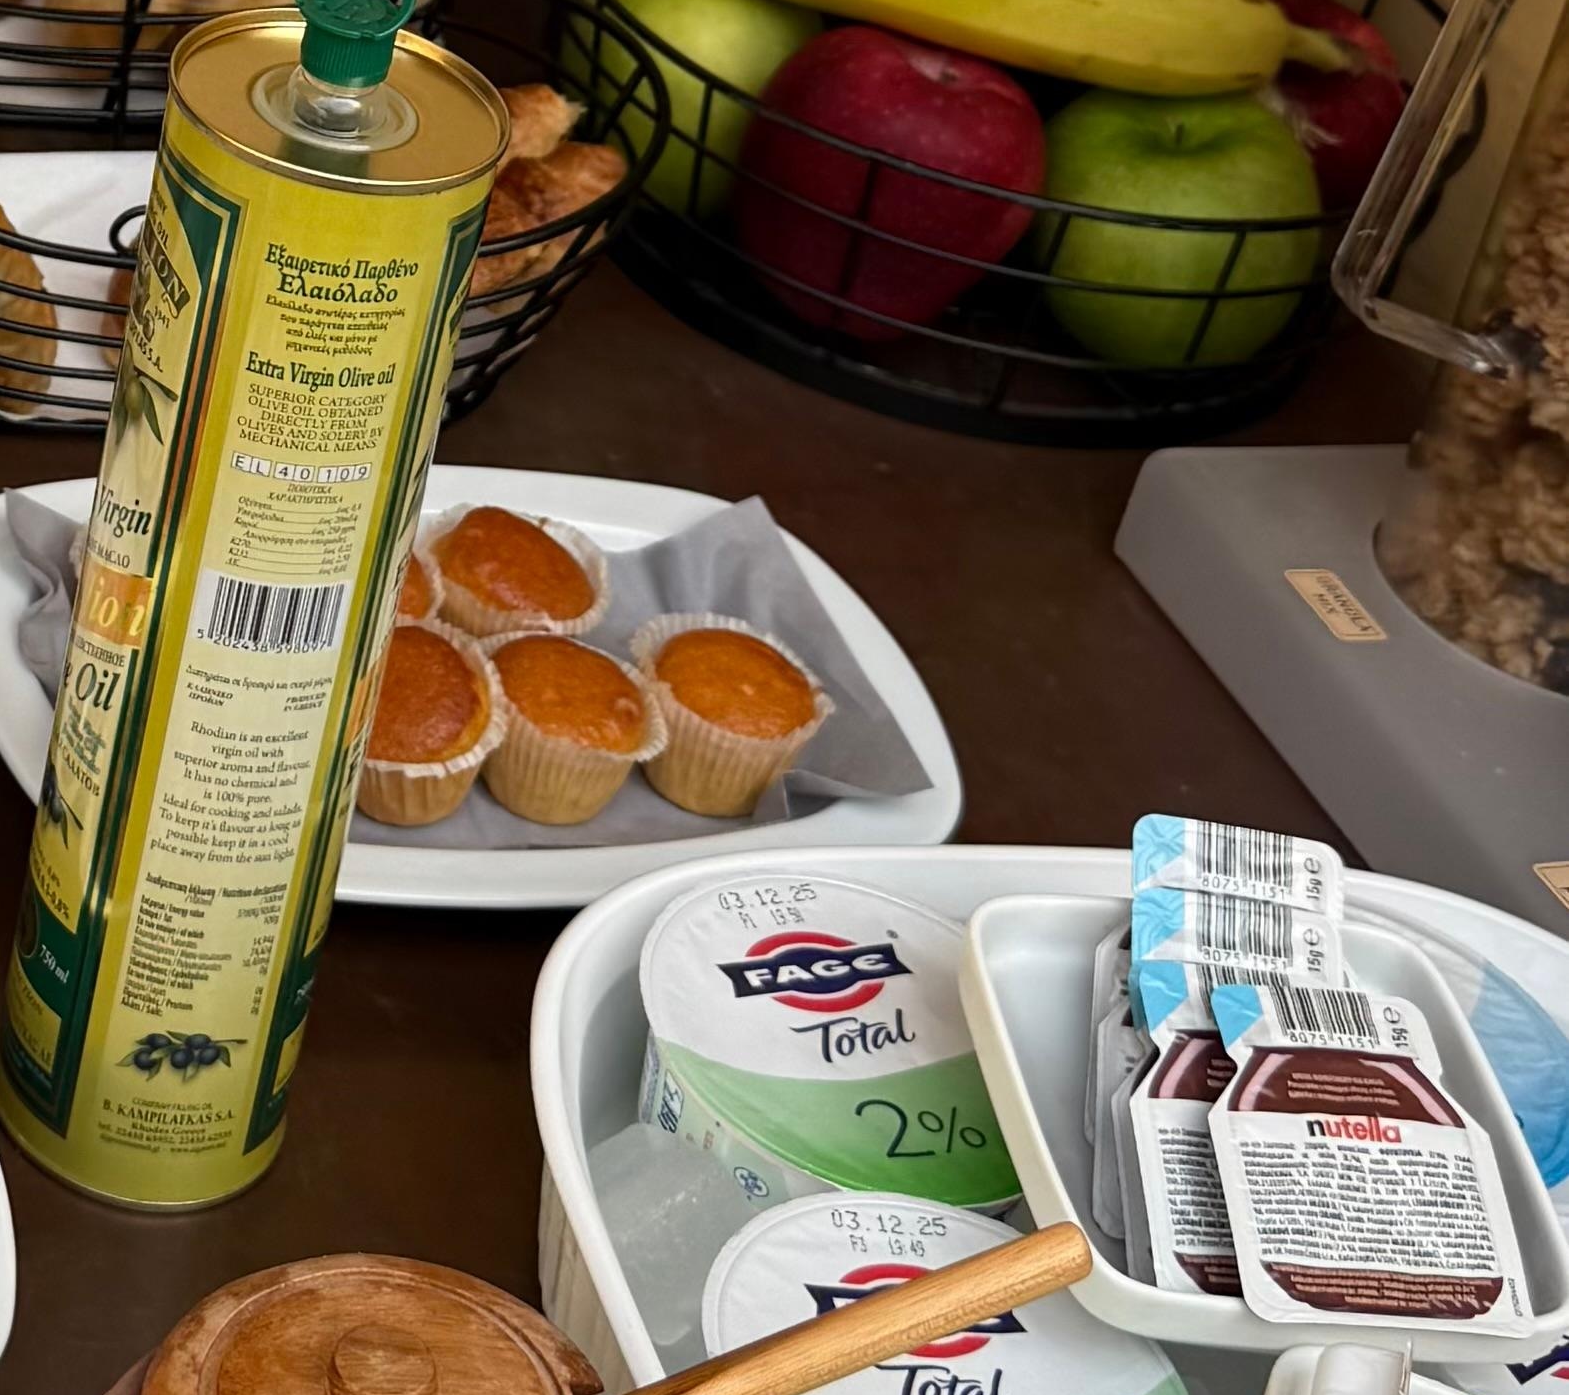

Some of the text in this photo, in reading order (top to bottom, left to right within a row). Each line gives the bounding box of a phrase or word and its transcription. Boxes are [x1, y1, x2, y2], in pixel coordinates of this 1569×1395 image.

[265, 243, 418, 284] Εξαιρετικό Παρθένο
[277, 272, 398, 303] Ελαιόλαδο
[246, 351, 397, 392] Extra Virgin Olive oil
[248, 383, 387, 406] SUPERIOR CATEGORY
[248, 396, 383, 418] OLIVE OIL OBTAINED
[238, 416, 384, 441] OLIVES AND SOLERY BY
[260, 410, 367, 430] DIRECTLY FROM
[239, 428, 377, 452] MECHANICAL MEANS
[279, 467, 311, 480] 40
[325, 467, 367, 480] 109
[96, 484, 152, 538] Virgin
[75, 663, 120, 712] Oil
[190, 721, 309, 742] Rhodian is an excellent
[174, 751, 275, 773] superior aroma and
[212, 744, 284, 759] virgin oil with
[183, 768, 192, 779] It
[194, 770, 212, 783] has
[214, 777, 229, 786] no
[231, 777, 277, 788] chemical
[163, 793, 189, 810] Ideal
[190, 800, 206, 813] for
[208, 805, 250, 821] cooking
[203, 788, 212, 800] is
[216, 789, 244, 803] 100%
[159, 807, 173, 820] To
[175, 813, 199, 830] keep
[219, 819, 255, 833] flavour
[150, 838, 177, 854] place
[179, 848, 206, 862] away
[207, 850, 234, 863] from
[235, 853, 252, 863] the
[166, 828, 209, 846] possible
[211, 835, 236, 852] keep
[238, 836, 246, 847] it
[248, 838, 258, 848] in
[718, 883, 817, 911] 03.12.25
[743, 953, 890, 988] FAGE
[789, 1008, 916, 1063] Total
[1288, 1029, 1375, 1049] 8075 1151
[854, 1099, 987, 1158] 2%
[1306, 1115, 1402, 1144] nutella
[830, 1208, 948, 1237] 03.12.25
